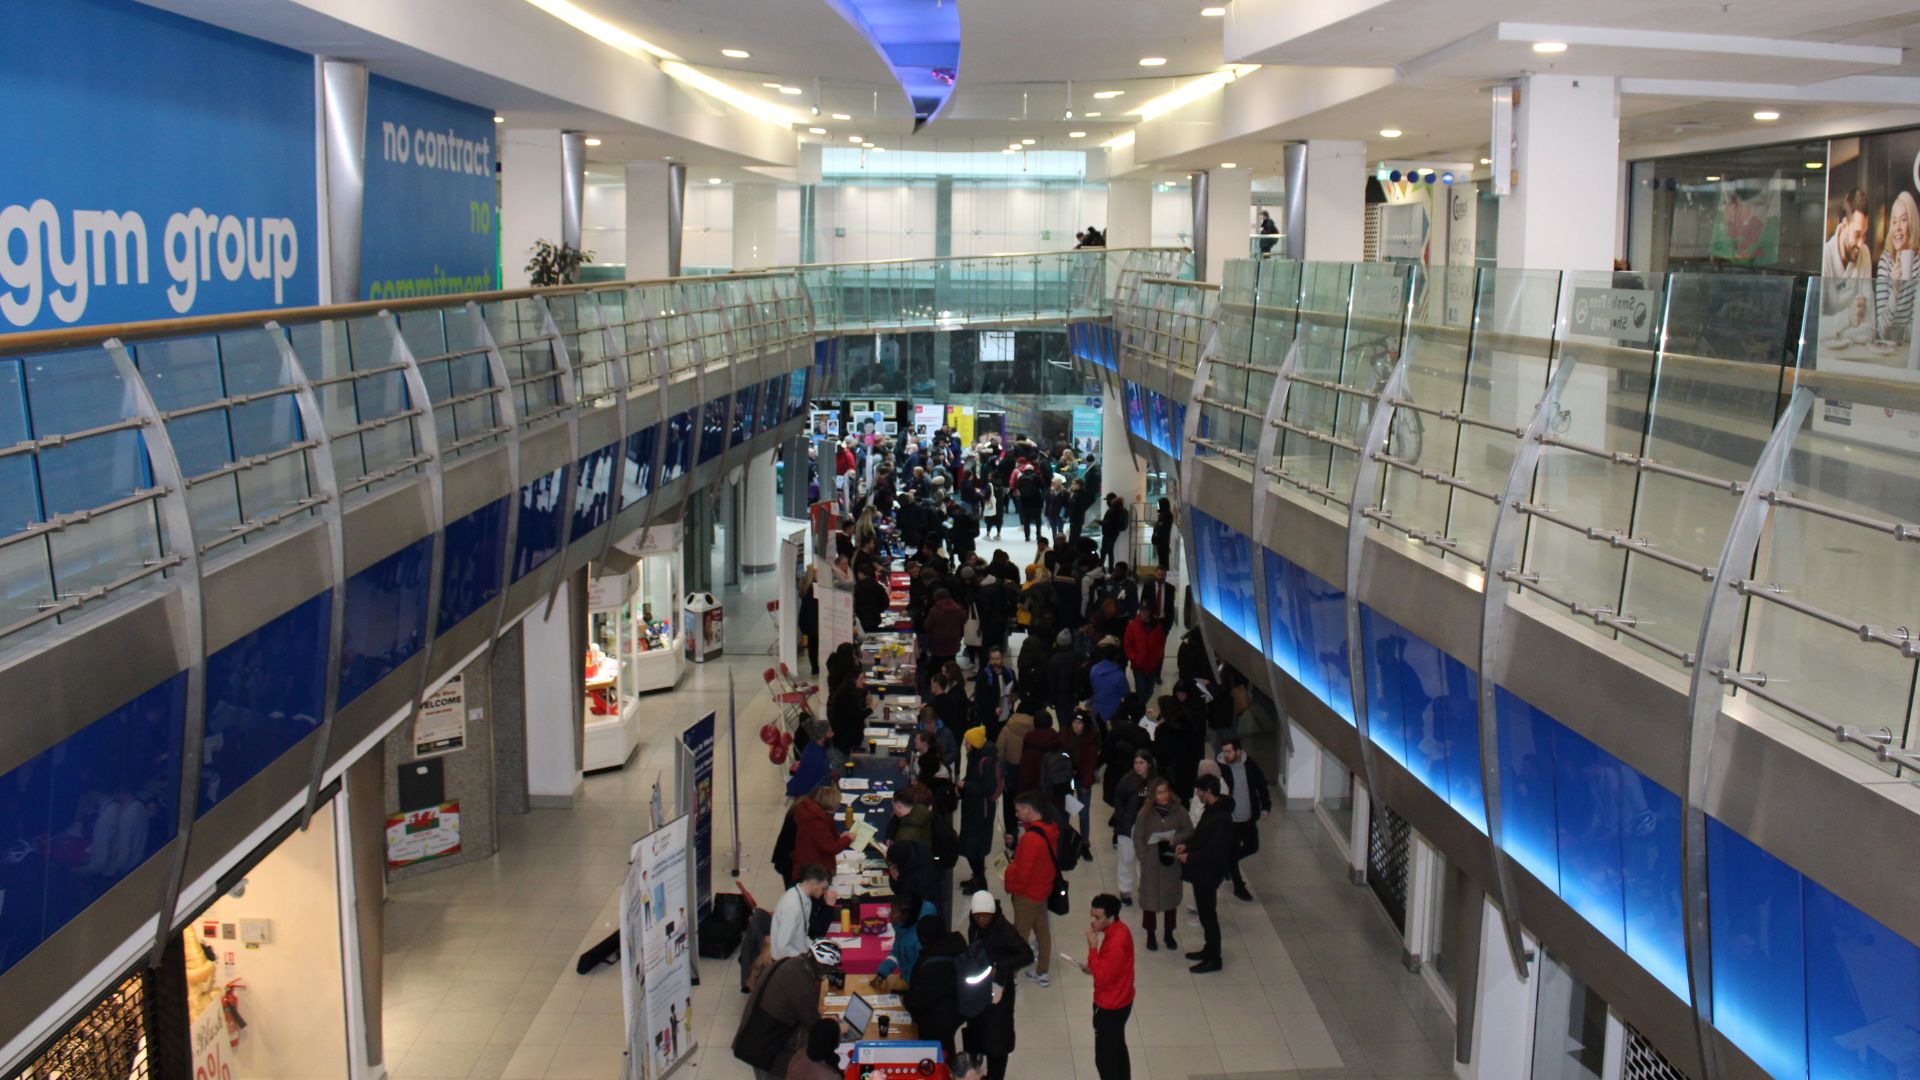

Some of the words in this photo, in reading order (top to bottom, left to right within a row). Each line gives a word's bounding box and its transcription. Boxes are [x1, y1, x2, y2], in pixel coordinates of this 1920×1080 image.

[383, 121, 410, 163] no
[414, 128, 490, 177] contract
[470, 200, 490, 234] no
[0, 199, 149, 327] gym
[164, 207, 299, 314] group
